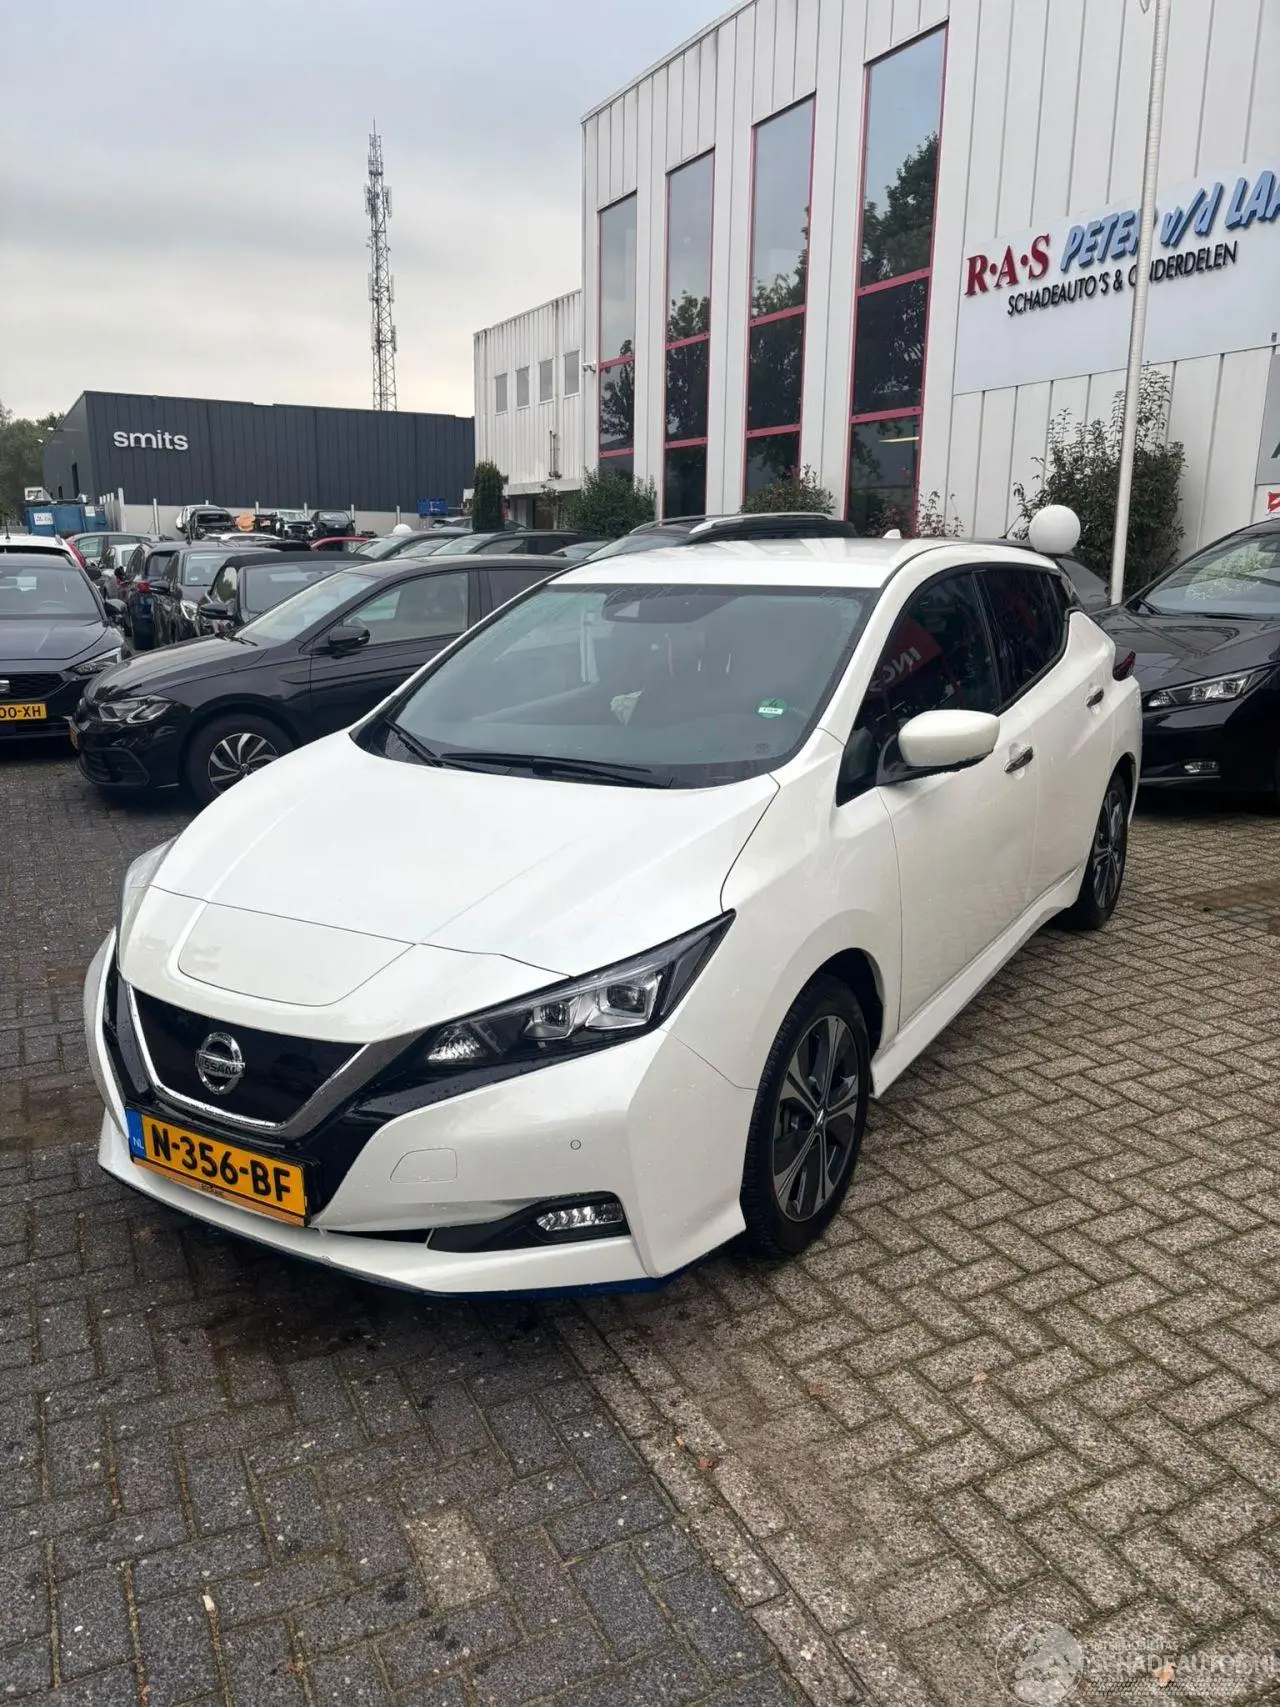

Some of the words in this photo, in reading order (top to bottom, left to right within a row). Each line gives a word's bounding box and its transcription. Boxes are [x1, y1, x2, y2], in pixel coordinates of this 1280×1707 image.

[1007, 271, 1110, 316] SCHADEAUTO'S
[1113, 269, 1124, 292] &
[1128, 241, 1239, 287] ODERDELEN
[113, 429, 189, 451] smits
[133, 1136, 145, 1150] NL
[151, 1124, 291, 1202] N-356-BF
